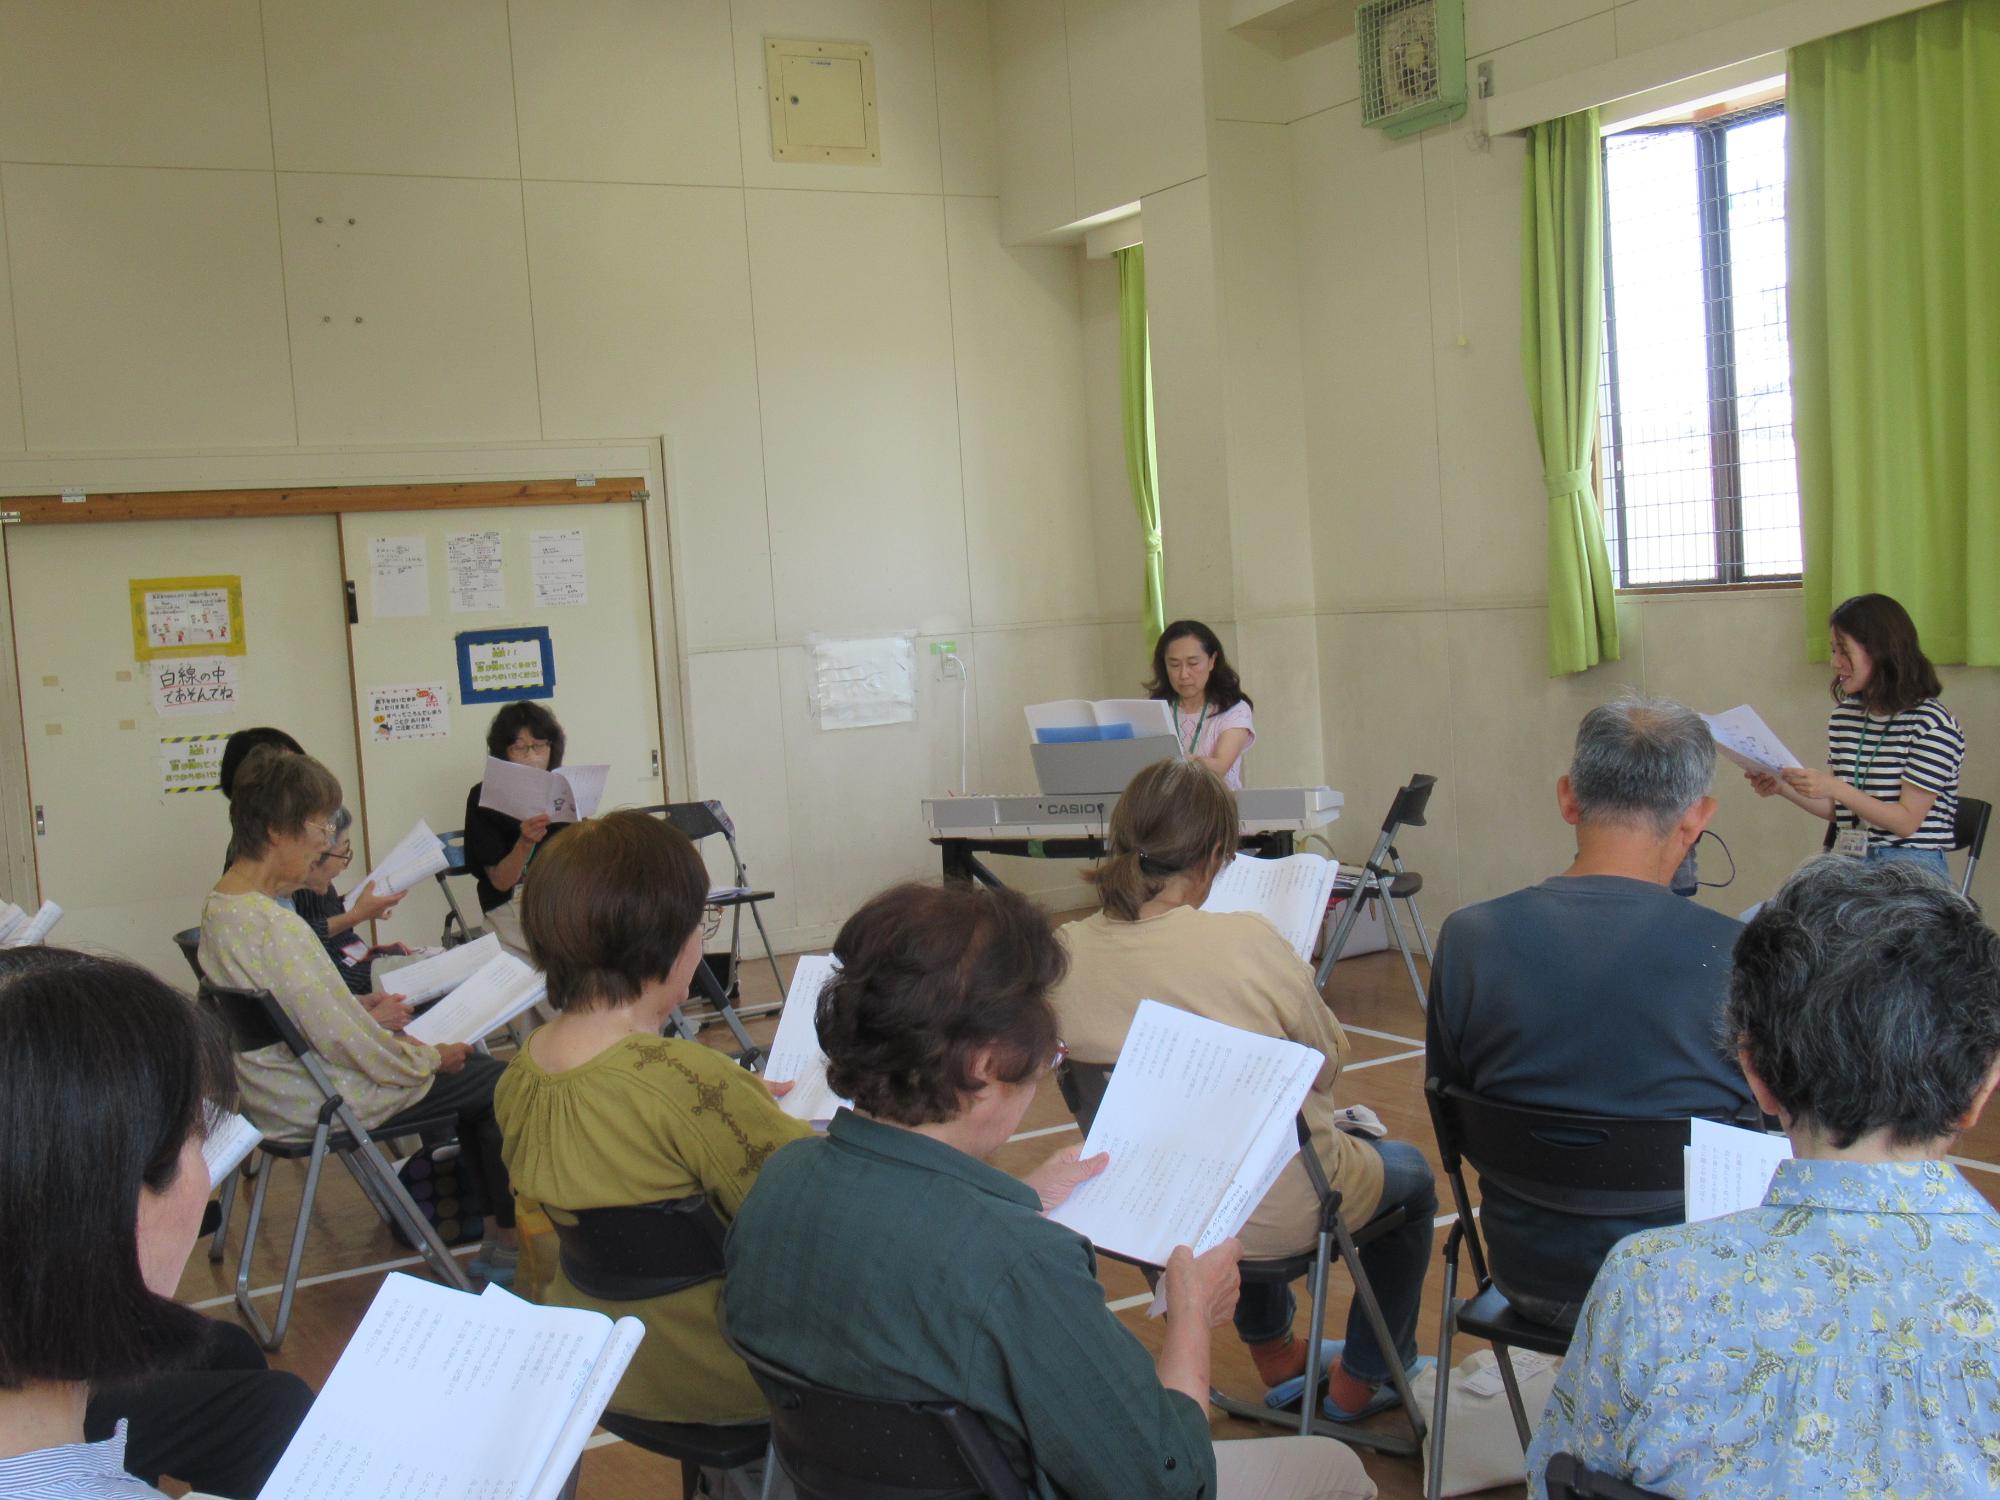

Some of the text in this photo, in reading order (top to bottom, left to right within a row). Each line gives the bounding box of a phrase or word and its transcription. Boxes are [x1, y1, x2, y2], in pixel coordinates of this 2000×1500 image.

[160, 666, 226, 688] 白線の中
[164, 685, 233, 704] であそんでね
[1048, 805, 1096, 814] CASIO
